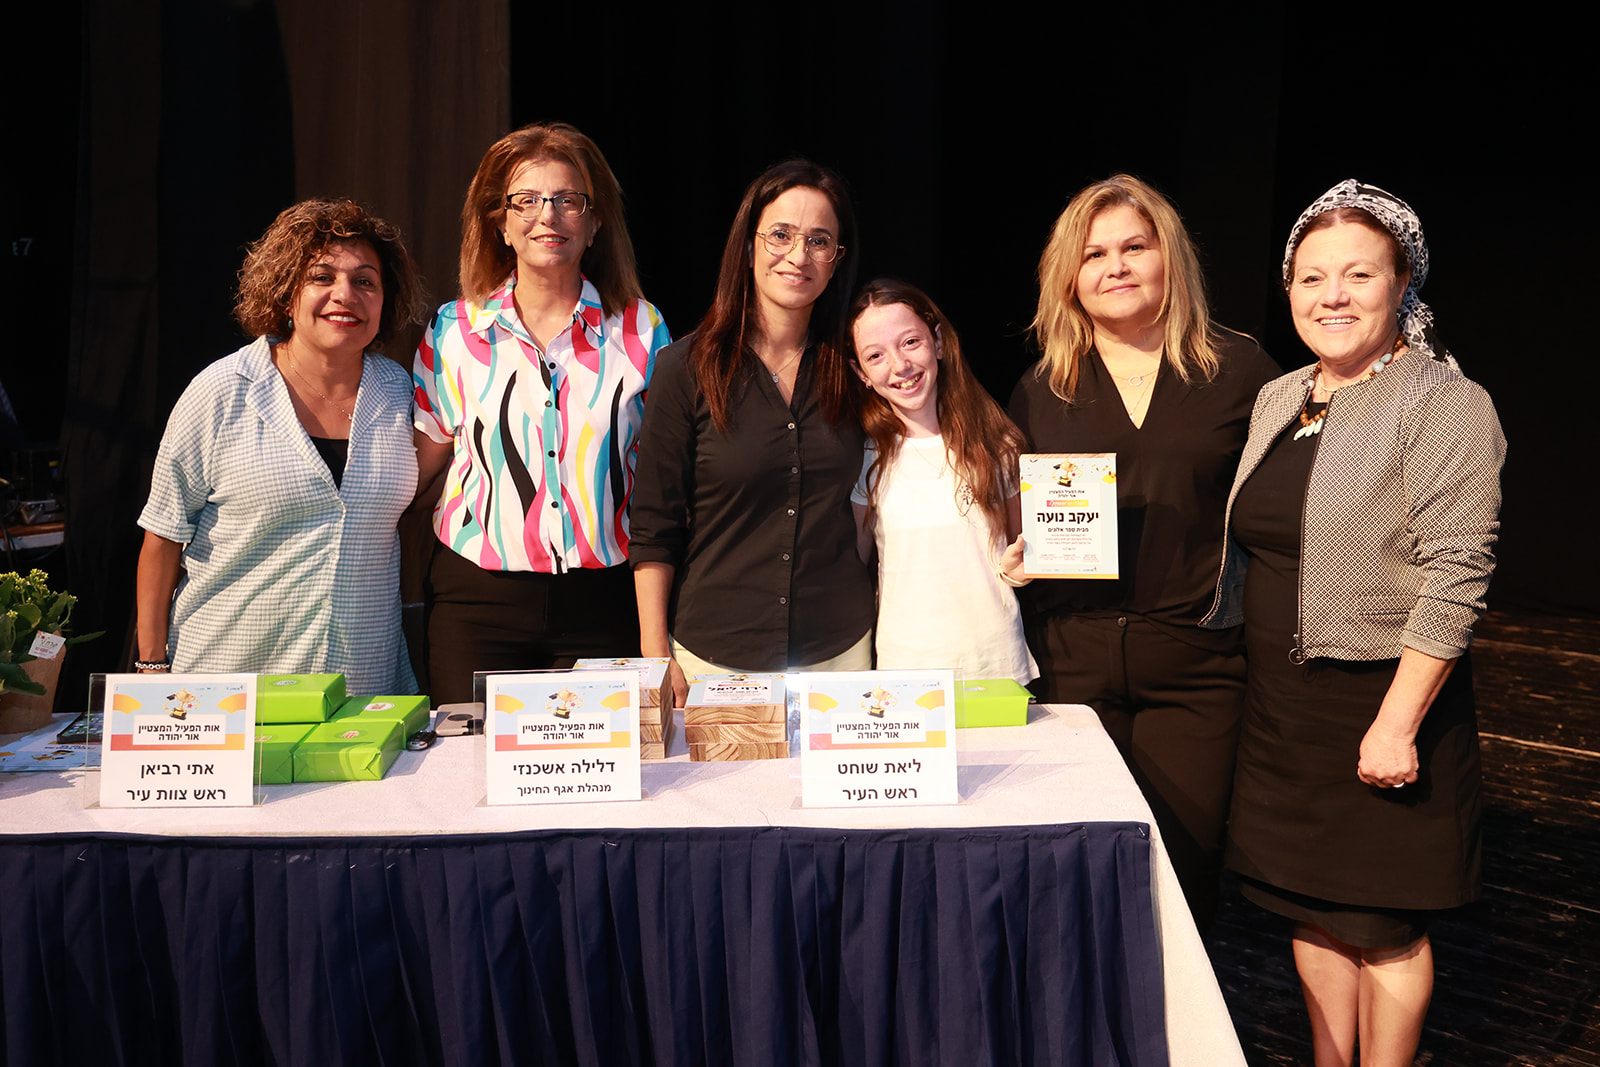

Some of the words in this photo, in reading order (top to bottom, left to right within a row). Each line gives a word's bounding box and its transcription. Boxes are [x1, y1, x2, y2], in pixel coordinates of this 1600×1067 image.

[1037, 512, 1064, 523] נועה
[1069, 512, 1098, 524] יעקב
[139, 724, 172, 735] המצטיין
[175, 723, 201, 732] הפעיל
[523, 724, 556, 734] המצטיין
[559, 722, 585, 731] הפעיל
[589, 722, 604, 730] אות
[837, 723, 871, 733] המצטיין
[874, 721, 900, 730] הפעיל
[543, 732, 566, 740] יהודה
[569, 731, 584, 739] אור
[858, 731, 882, 739] יהודה
[141, 764, 180, 778] רביאן
[188, 763, 214, 774] אתי
[514, 763, 565, 775] אשכנזי
[572, 758, 615, 773] דלילה
[838, 762, 878, 774] שוחט
[884, 758, 921, 773] ליאת
[517, 786, 549, 796] החינוך
[554, 785, 573, 795] אגף
[578, 782, 611, 792] מנהלת
[127, 789, 150, 801] עיר
[156, 789, 187, 800] צוות
[194, 789, 225, 800] ראש
[843, 788, 878, 800] העיר
[885, 787, 917, 799] ראש
